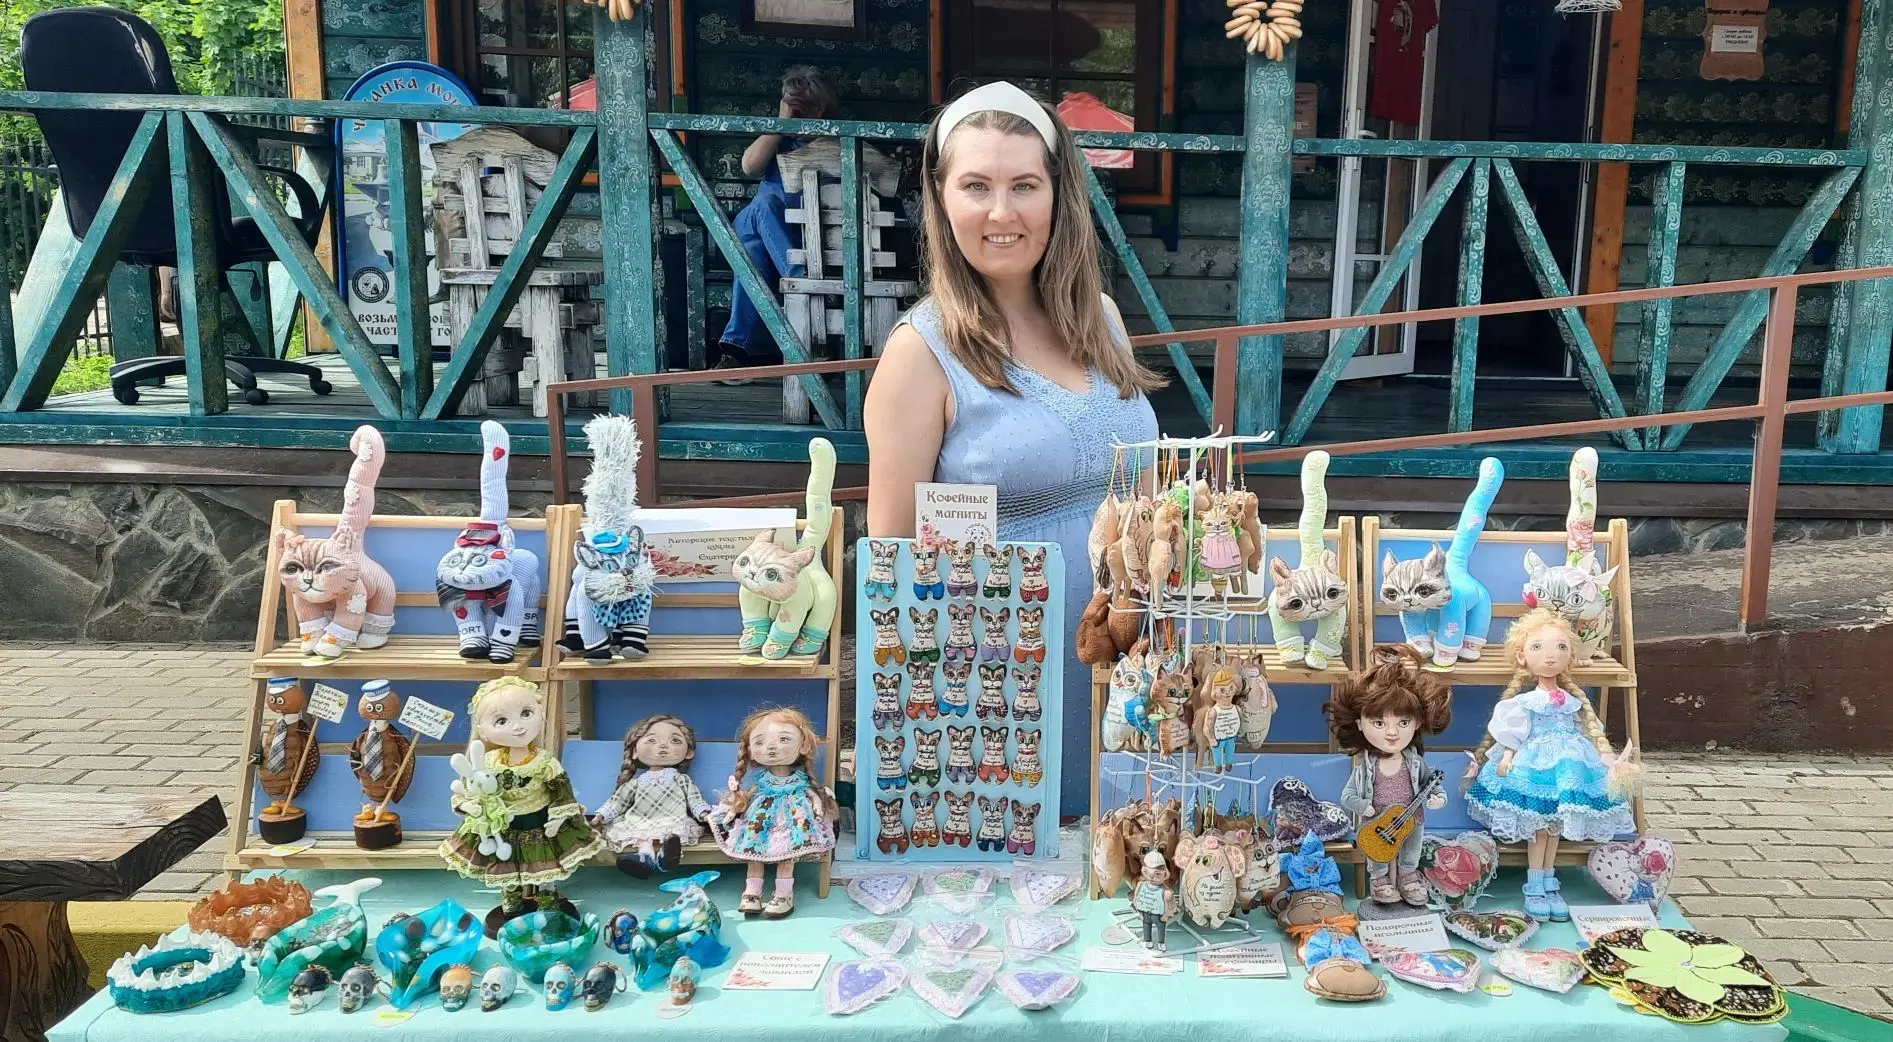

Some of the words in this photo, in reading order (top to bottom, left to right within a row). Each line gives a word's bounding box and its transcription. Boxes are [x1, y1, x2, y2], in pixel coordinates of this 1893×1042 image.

[926, 490, 989, 504] Кофейные
[934, 509, 988, 520] магниты
[667, 536, 716, 544] Авторские
[1576, 914, 1653, 923] Сервировочные
[1365, 920, 1434, 932] Подарочные
[1373, 928, 1435, 938] игольницы
